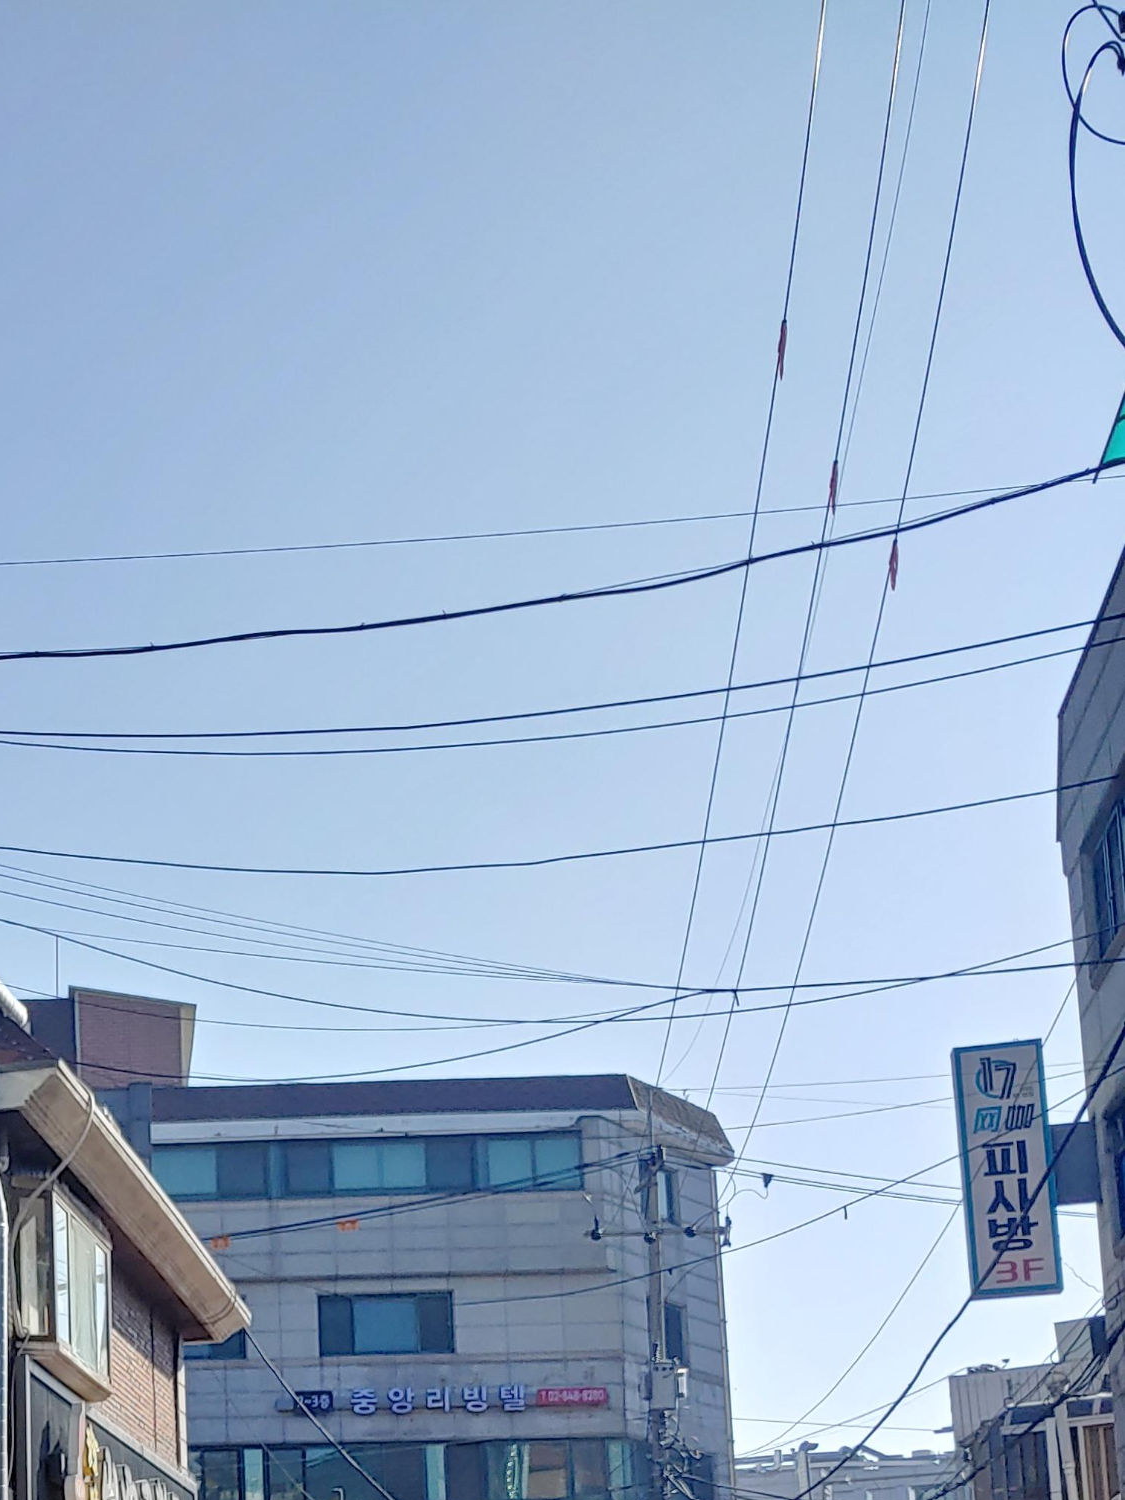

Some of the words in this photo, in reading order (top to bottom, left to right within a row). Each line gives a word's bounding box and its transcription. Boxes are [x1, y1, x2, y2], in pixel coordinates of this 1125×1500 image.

[982, 1140, 1039, 1252] 피시방
[995, 1258, 1044, 1284] 3F
[350, 1385, 525, 1415] 중앙리빙텔
